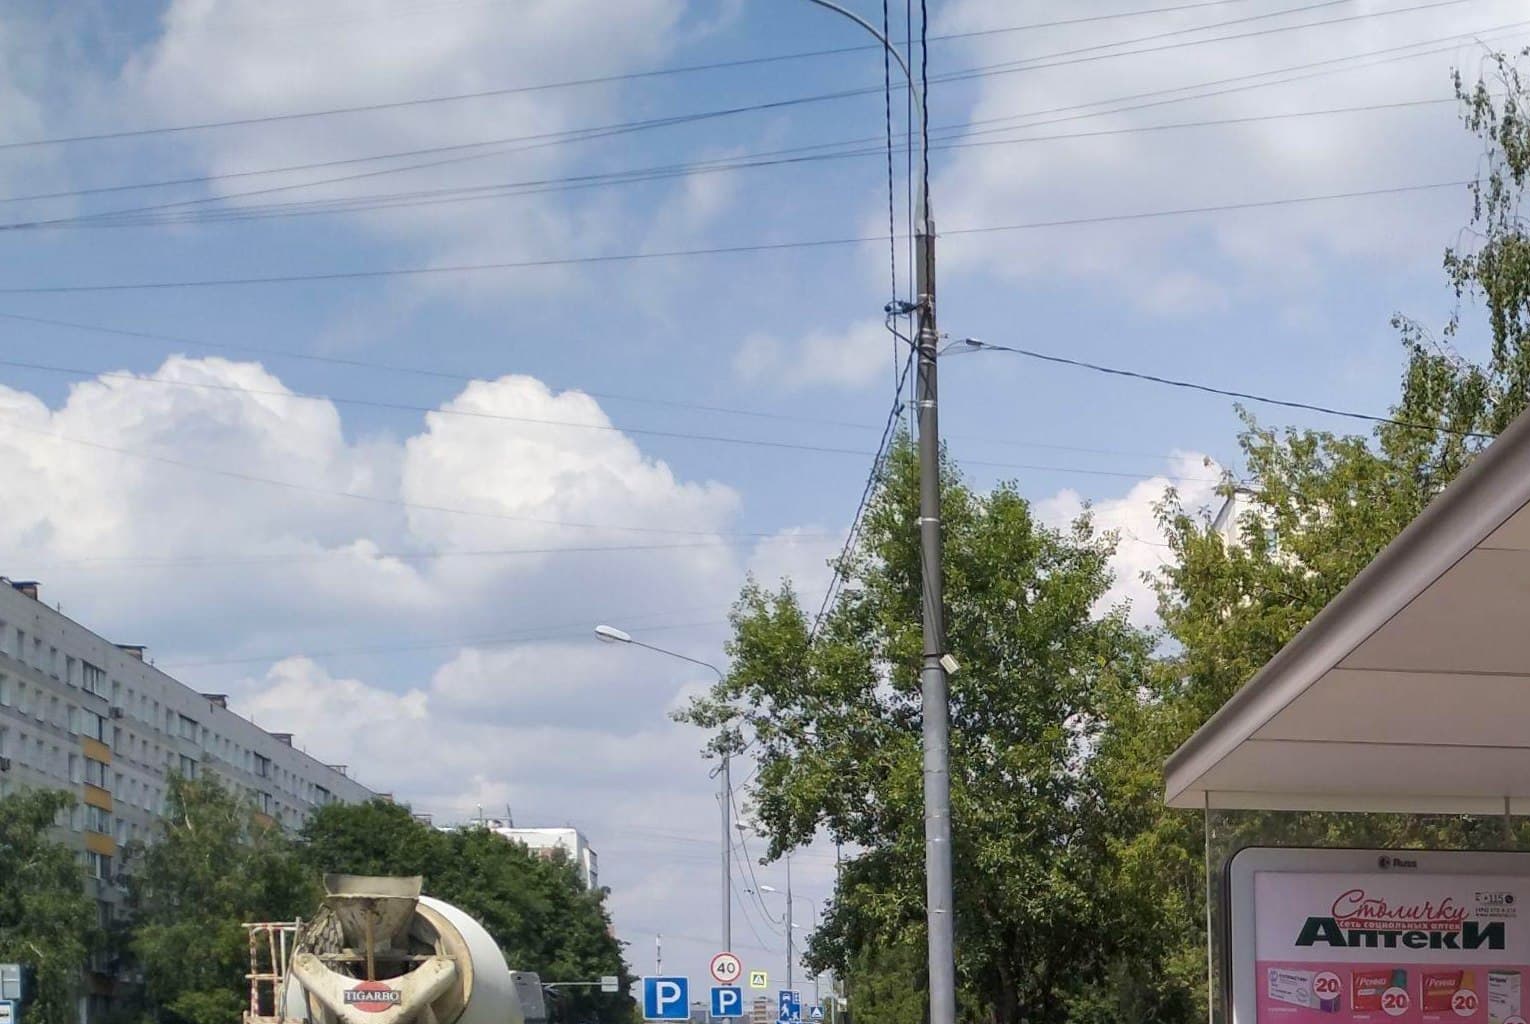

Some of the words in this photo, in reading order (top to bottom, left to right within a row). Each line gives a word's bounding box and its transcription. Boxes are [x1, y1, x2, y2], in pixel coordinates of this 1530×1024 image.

[1331, 888, 1469, 921] Столички
[717, 962, 736, 974] 40
[656, 981, 681, 1015] P
[719, 990, 738, 1013] P
